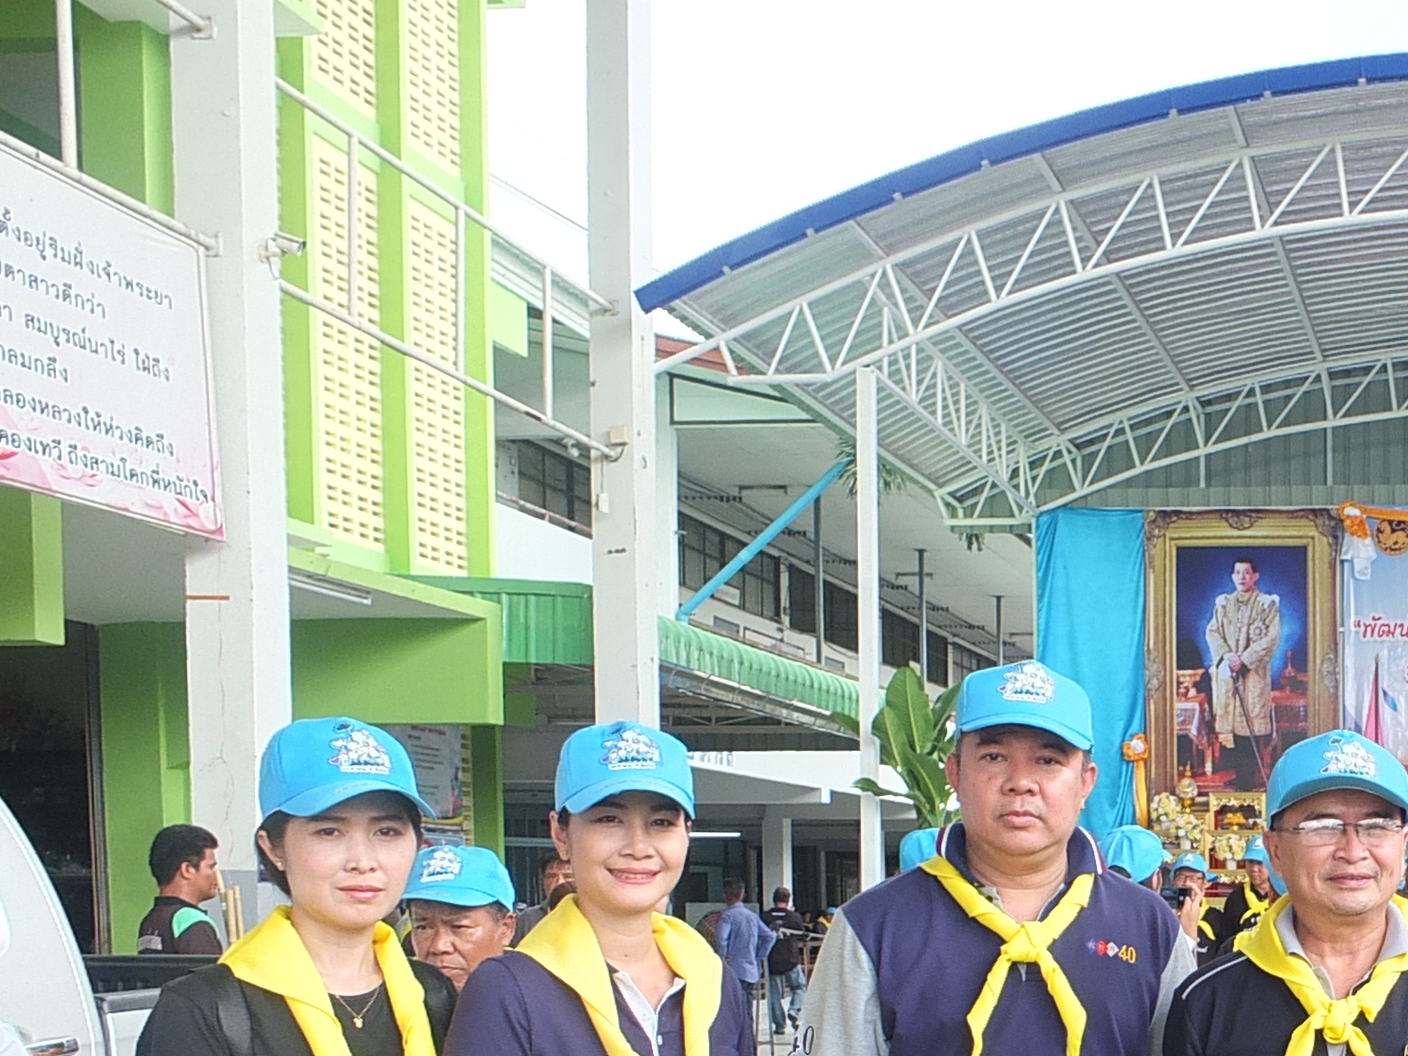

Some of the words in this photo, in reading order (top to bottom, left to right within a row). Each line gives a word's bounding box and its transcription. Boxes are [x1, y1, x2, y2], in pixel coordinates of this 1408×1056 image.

[0, 260, 106, 319] ตาสาวดีกว่า
[0, 387, 174, 457] ลองหลวงให้ห่วงคิดถึง
[1118, 944, 1137, 964] 40
